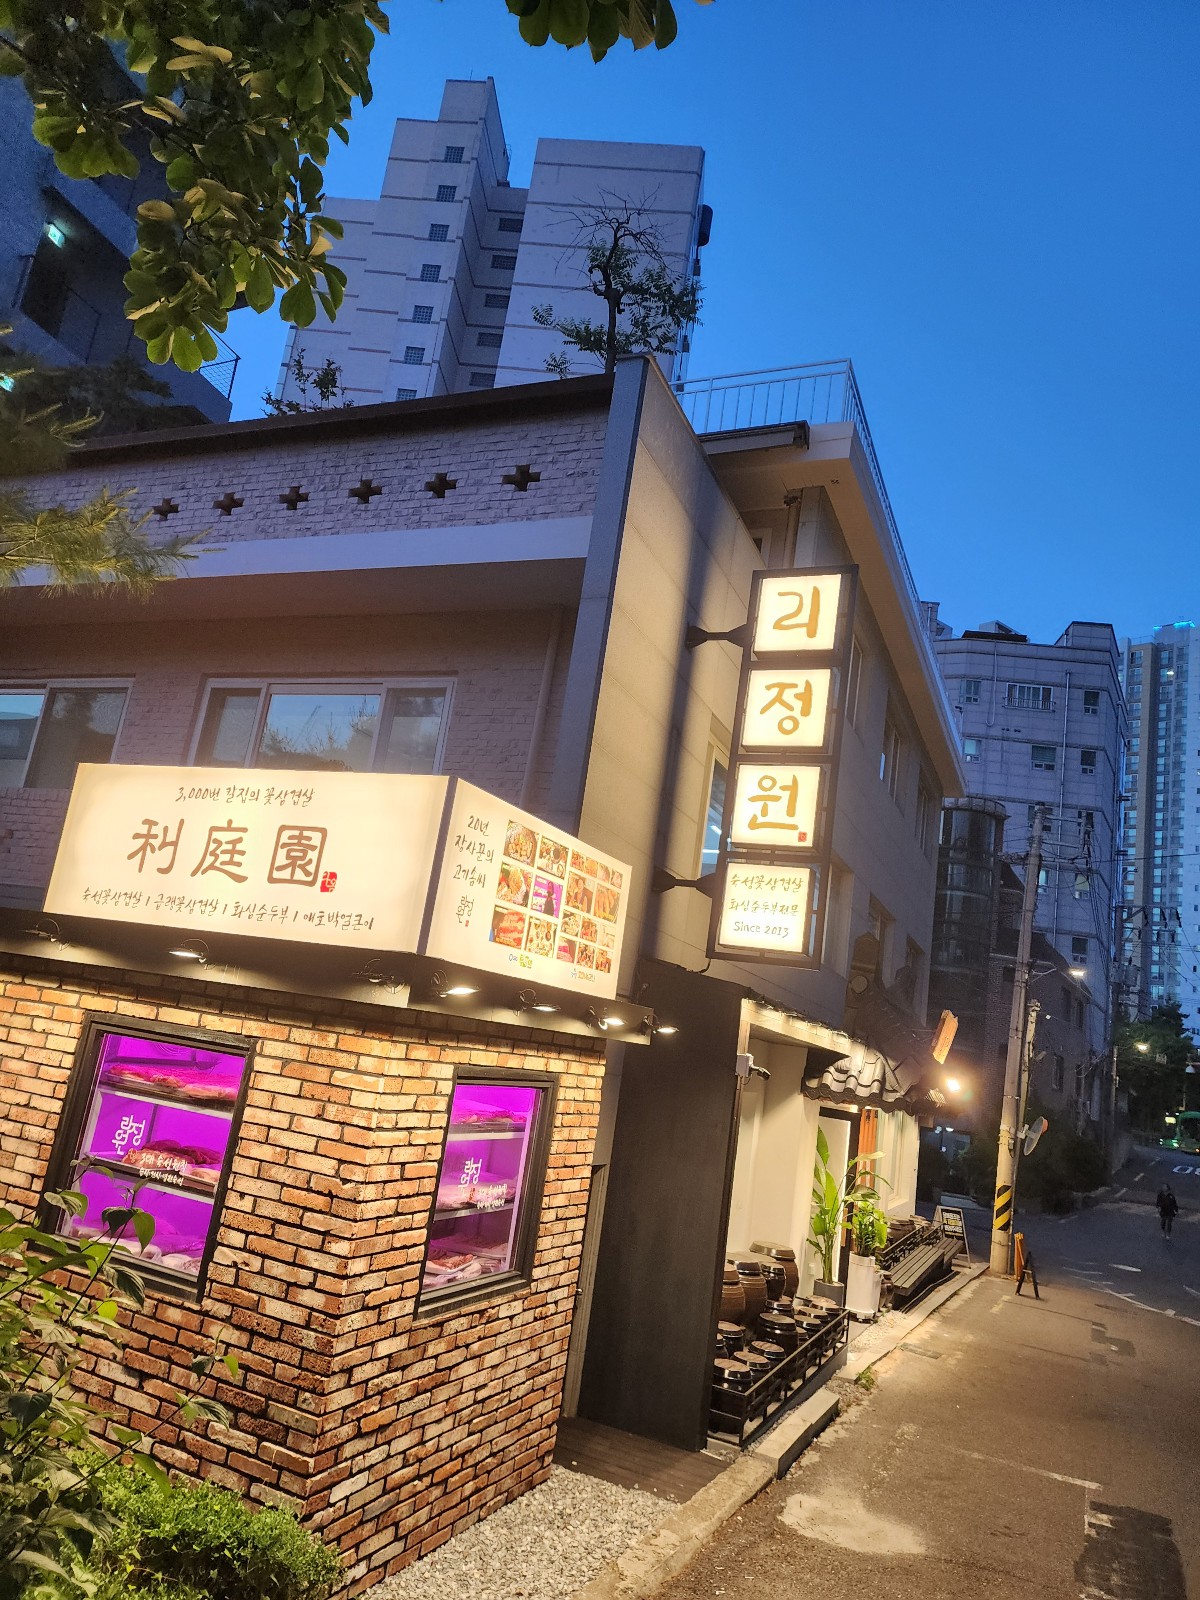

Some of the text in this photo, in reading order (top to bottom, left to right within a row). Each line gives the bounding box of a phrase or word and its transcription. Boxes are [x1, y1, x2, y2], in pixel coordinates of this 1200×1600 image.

[175, 785, 316, 808] 3,000번 칼집의 꽃삼겹살
[467, 815, 490, 837] 20년
[126, 817, 328, 888] 利庭園
[454, 834, 495, 864] 장사꾼의
[453, 864, 486, 889] 고기솜씨
[730, 873, 804, 893] 숙성꽃삼겹살
[82, 886, 143, 909] 숙성꽃삼겹살
[230, 901, 289, 924] 화심순두부
[303, 910, 375, 931] 애호박얼큰이
[728, 898, 799, 917] 화심순두부전문
[733, 921, 789, 939] Since 2013
